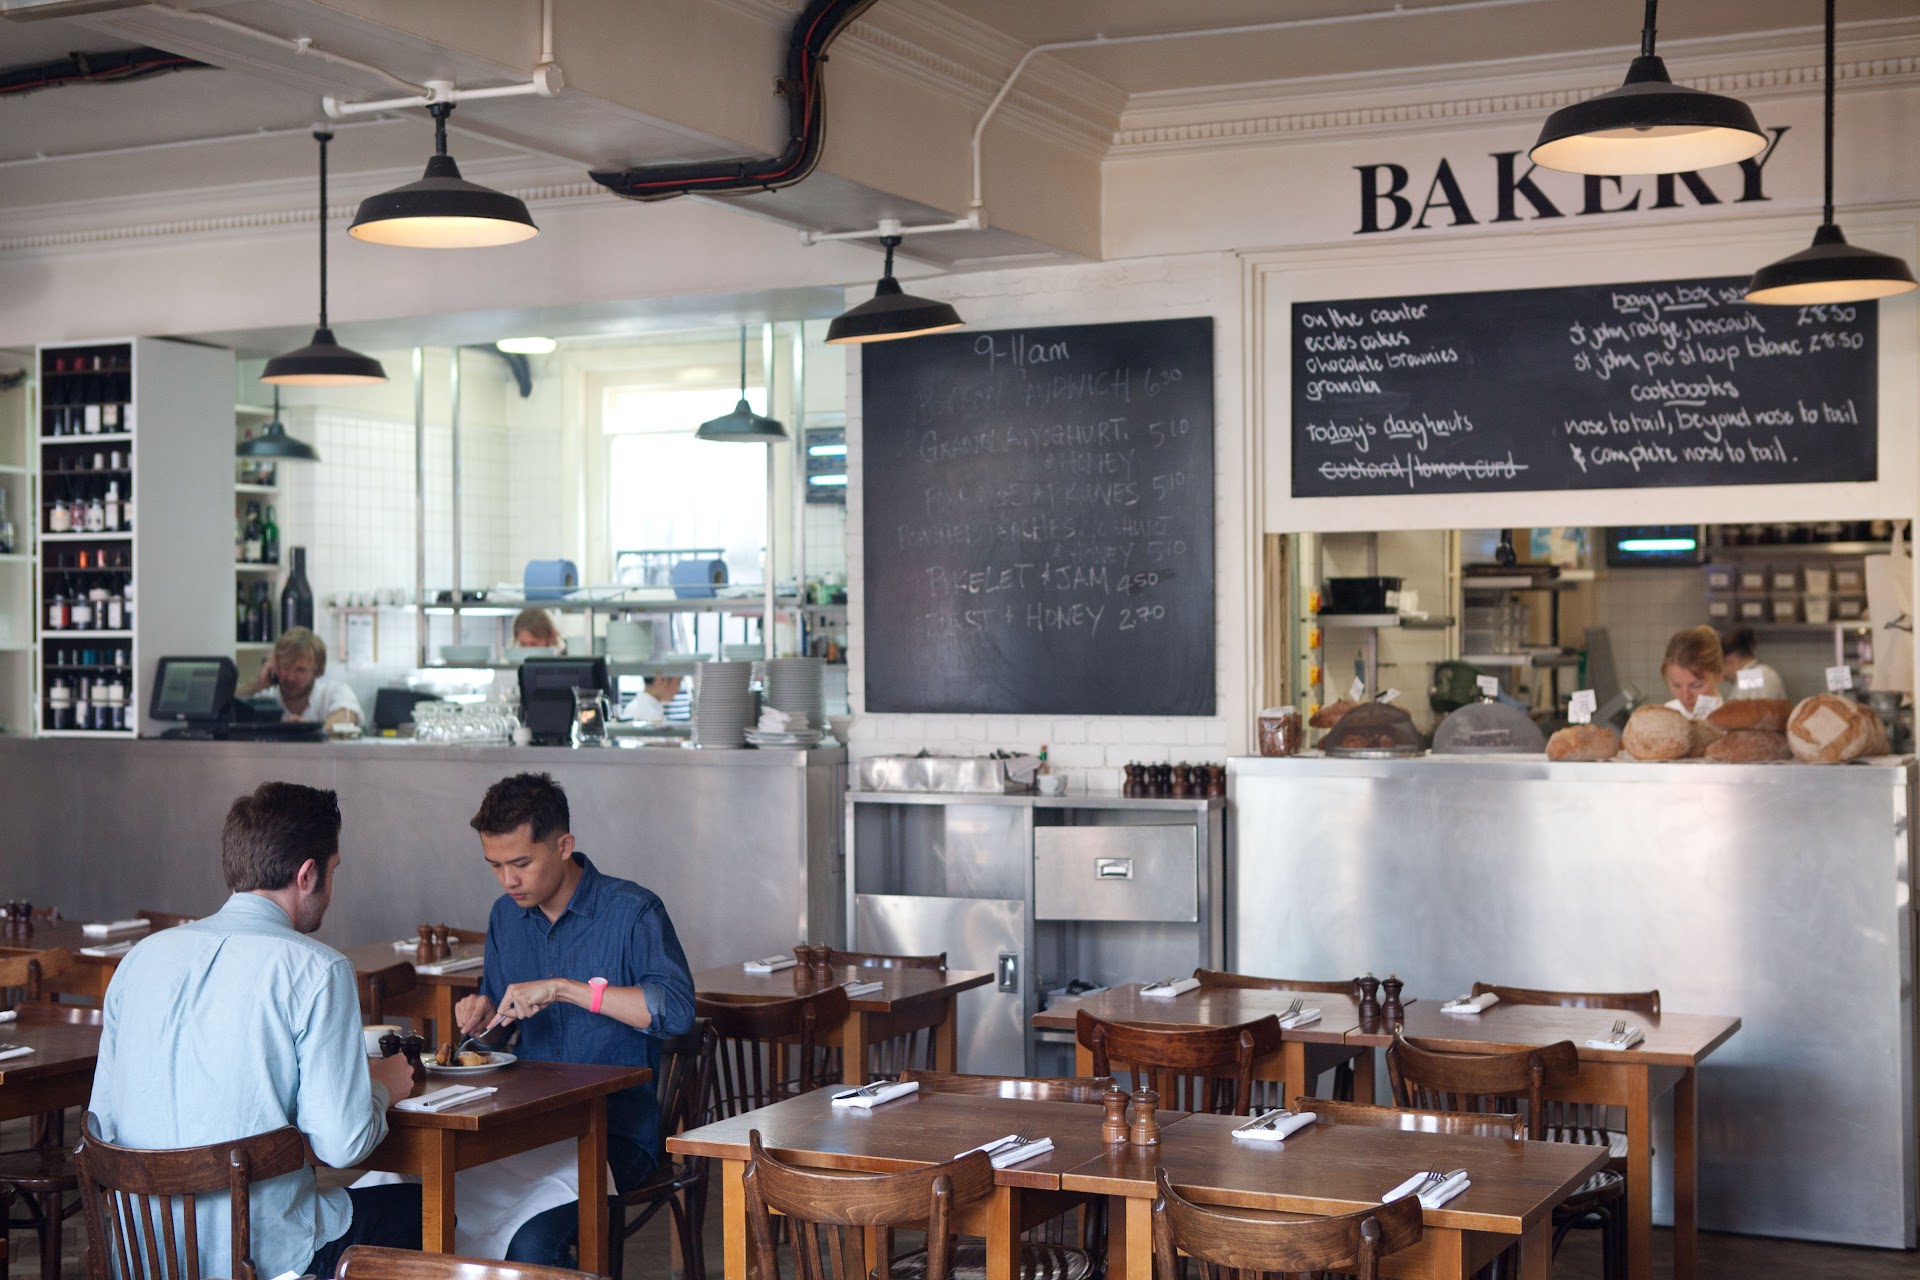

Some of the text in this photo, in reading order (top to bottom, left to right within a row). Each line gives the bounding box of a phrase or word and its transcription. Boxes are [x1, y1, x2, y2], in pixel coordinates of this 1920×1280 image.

[1676, 285, 1720, 307] box
[1302, 302, 1429, 329] on the counter
[1305, 330, 1411, 352] eccles cakes
[1569, 319, 1587, 345] st
[1588, 322, 1631, 350] john
[974, 333, 1070, 373] 9-11am
[1305, 346, 1459, 374] chocolate brownies
[1573, 350, 1592, 372] st
[1595, 347, 1641, 380] john
[1678, 342, 1697, 365] st
[1697, 341, 1741, 372] loup
[1745, 335, 1804, 358] blanc
[1809, 331, 1865, 354] 28.50
[1305, 374, 1383, 401] granola
[1630, 373, 1741, 401] cookbooks
[1305, 416, 1377, 453] today's
[1564, 418, 1608, 436] nose
[1608, 409, 1630, 434] to
[1675, 405, 1752, 444] beyond
[1755, 407, 1795, 426] nose
[1797, 399, 1819, 425] to
[1822, 398, 1859, 425] tail
[1590, 440, 1678, 473] complete
[1682, 445, 1724, 463] nose
[1724, 437, 1746, 463] to
[1055, 564, 1110, 596] JAM
[1027, 602, 1106, 639] HONEY
